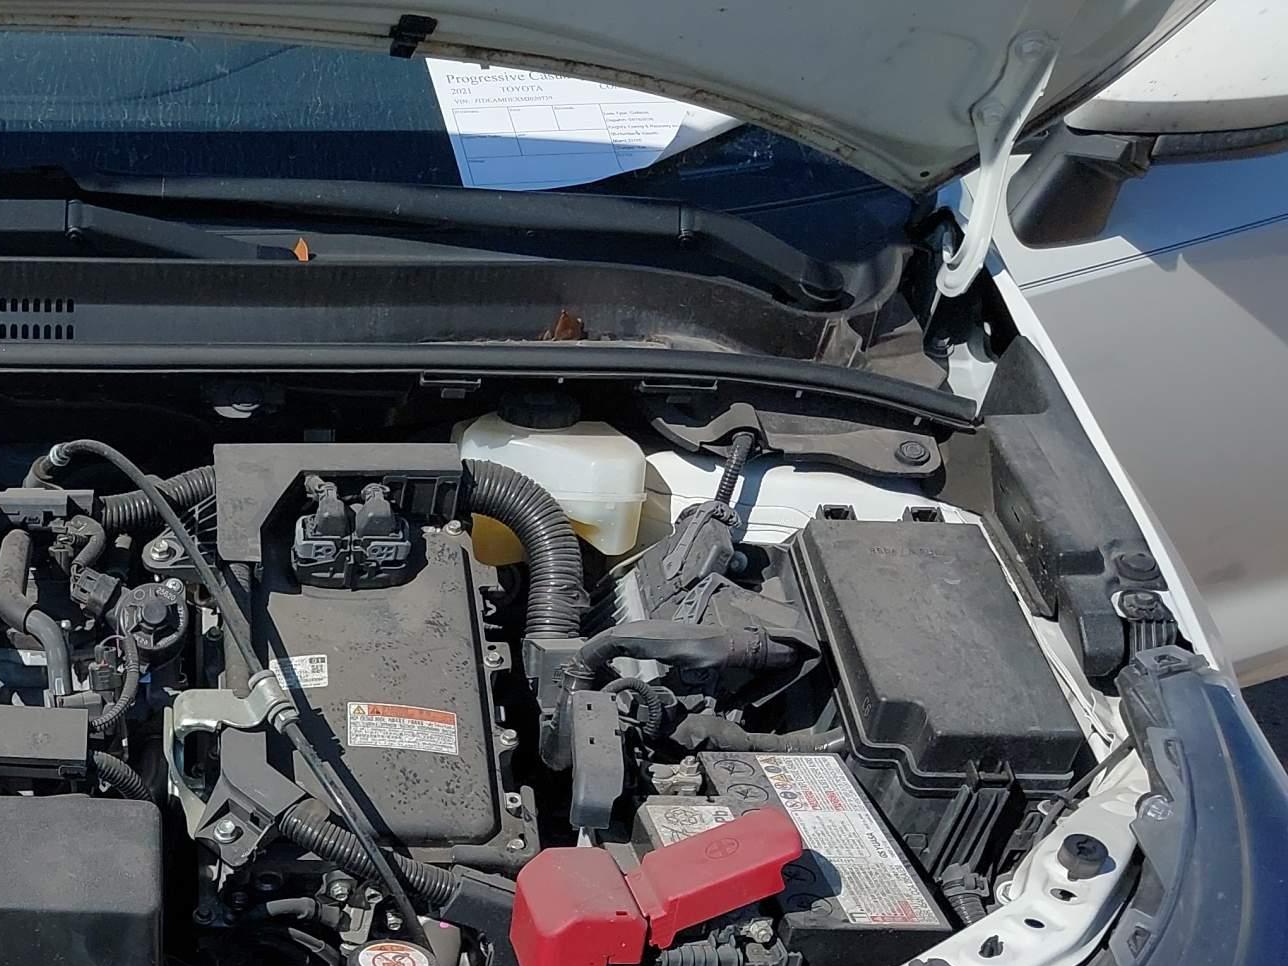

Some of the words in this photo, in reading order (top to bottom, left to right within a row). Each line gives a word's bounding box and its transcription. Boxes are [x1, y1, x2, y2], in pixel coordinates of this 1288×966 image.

[447, 72, 525, 85] Progressive
[450, 87, 472, 96] 2021
[500, 84, 544, 94] TOYOTA
